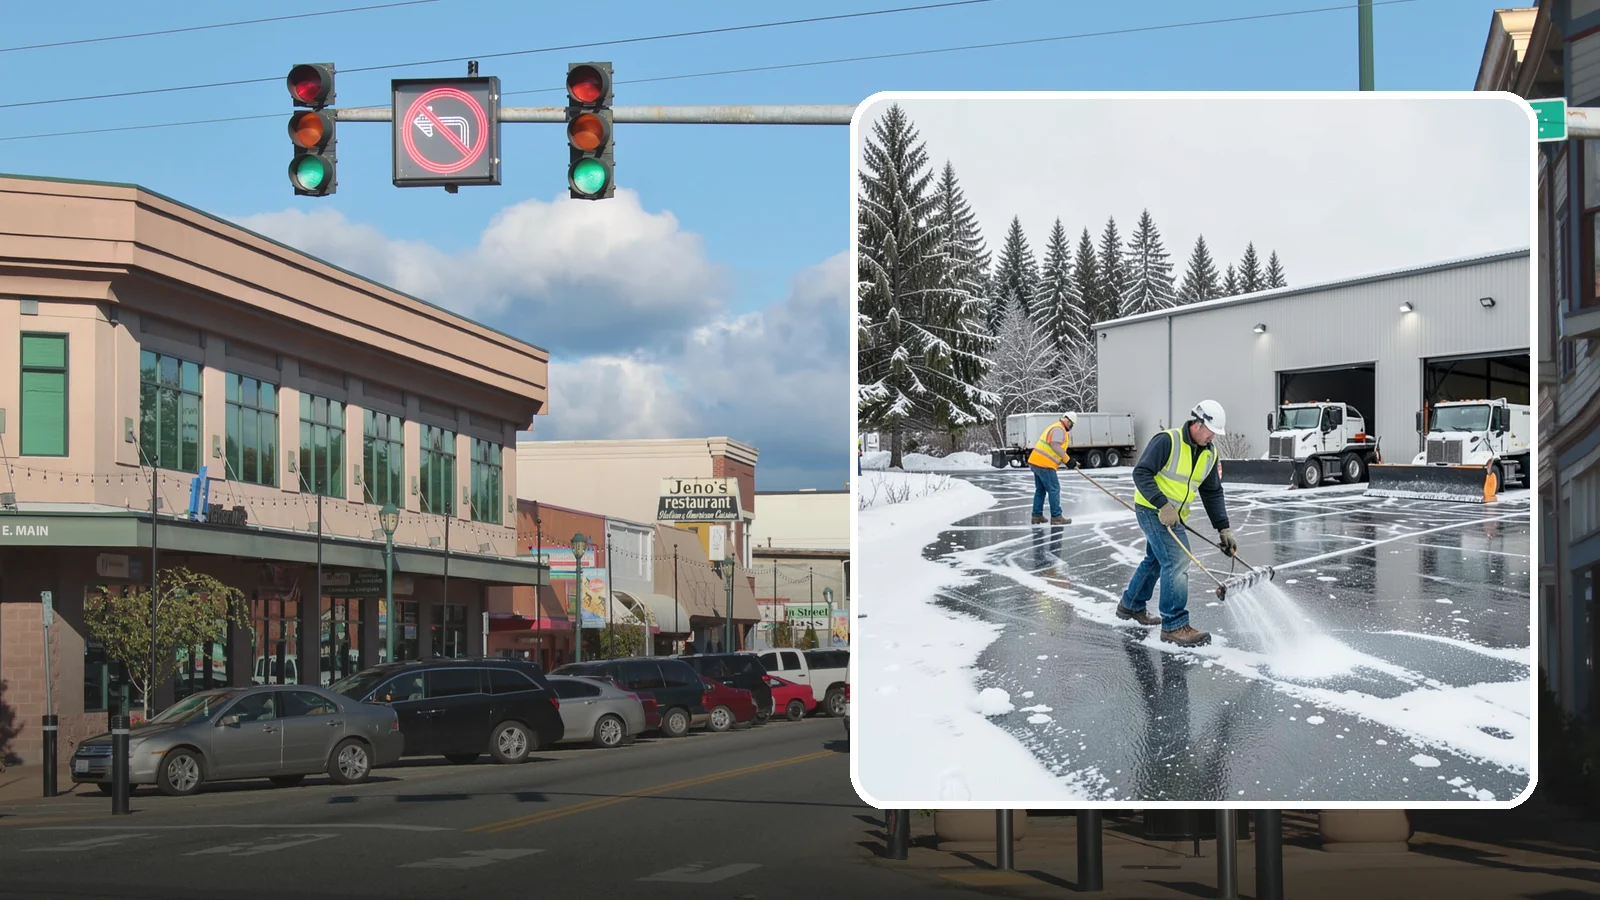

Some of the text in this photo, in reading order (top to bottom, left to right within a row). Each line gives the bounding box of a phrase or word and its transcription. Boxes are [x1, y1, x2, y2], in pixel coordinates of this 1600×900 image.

[669, 480, 727, 494] Jeno's
[665, 496, 731, 509] restaurant
[658, 510, 681, 519] Italian
[686, 510, 714, 519] American
[715, 510, 737, 519] Cuisine
[2, 525, 49, 536] E. MAIN
[797, 608, 828, 617] Street
[790, 619, 823, 627] lass
